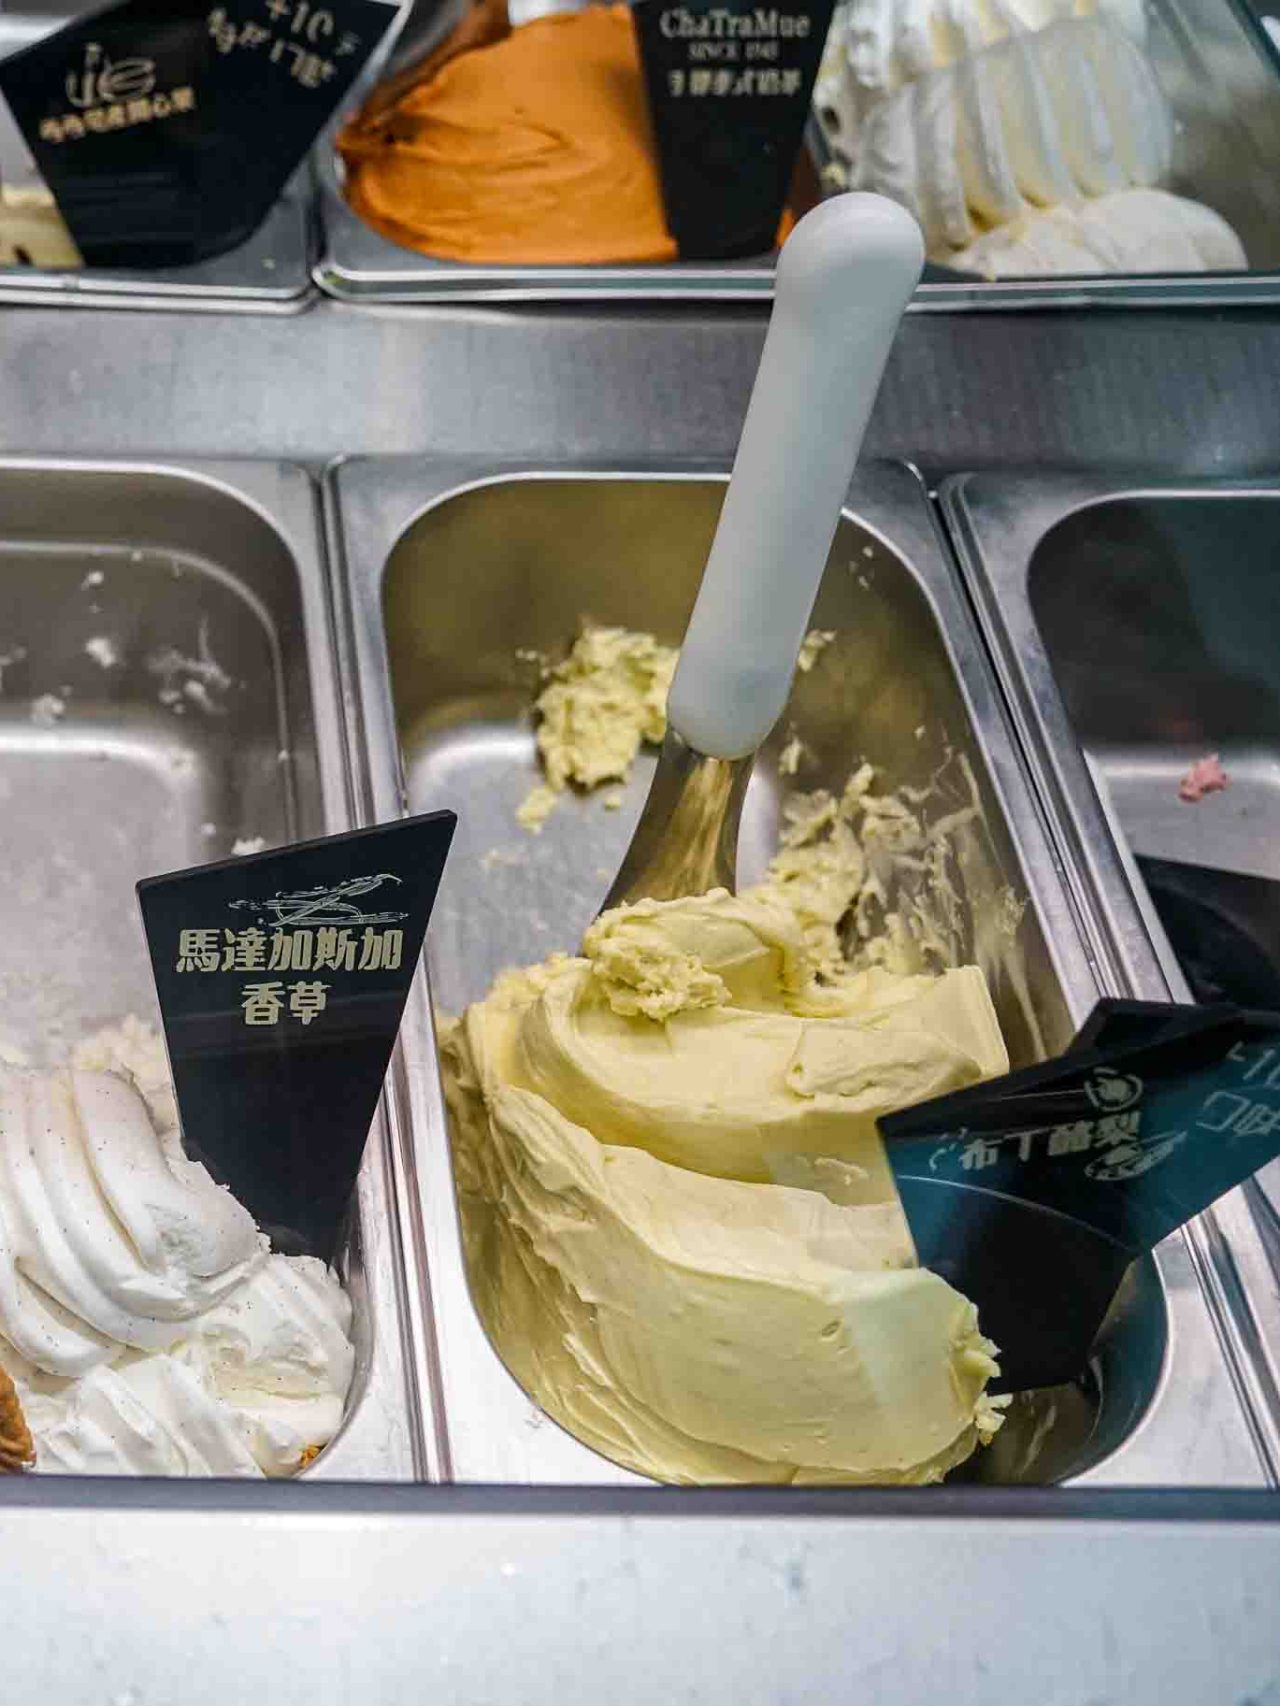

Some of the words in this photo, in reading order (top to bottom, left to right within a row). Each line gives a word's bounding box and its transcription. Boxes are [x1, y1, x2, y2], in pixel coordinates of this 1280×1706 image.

[176, 926, 404, 973] 馬達加斯加
[240, 980, 332, 1026] 香草
